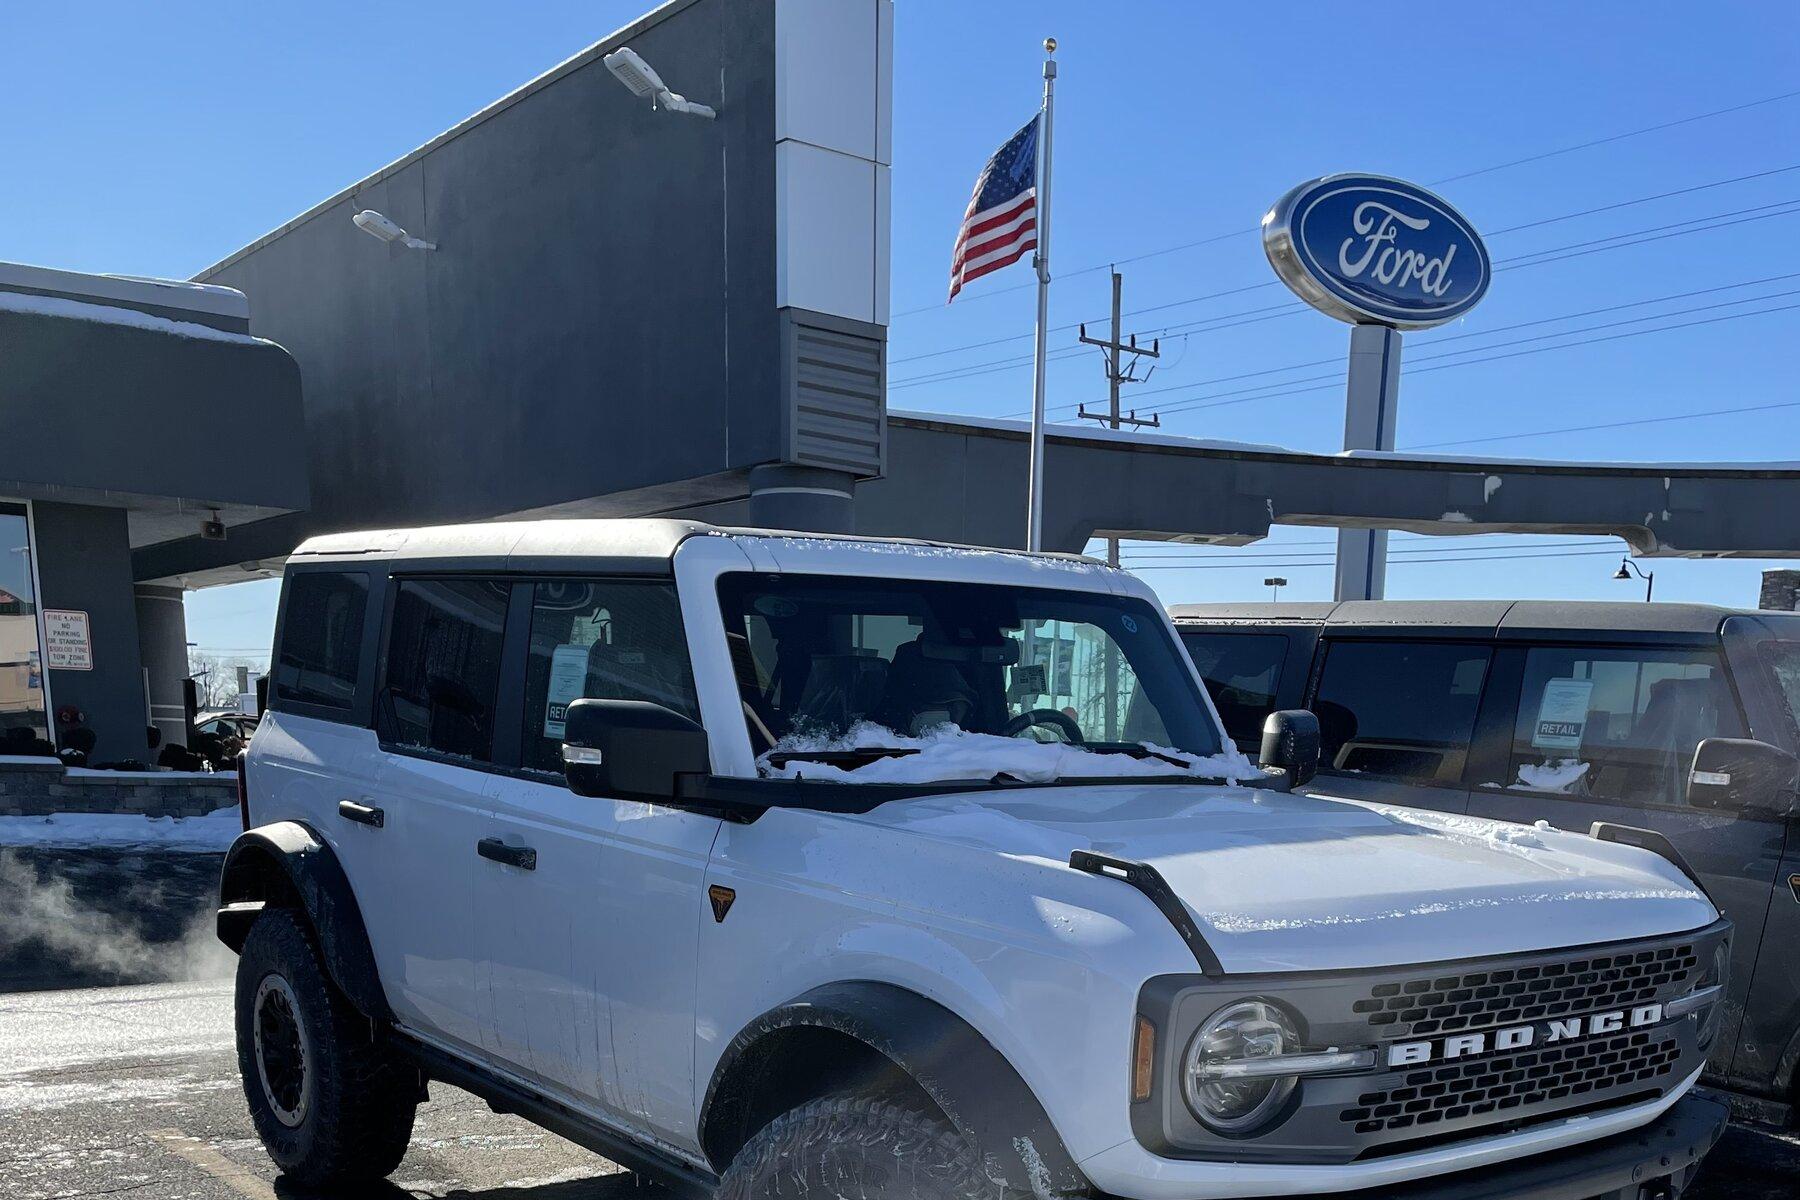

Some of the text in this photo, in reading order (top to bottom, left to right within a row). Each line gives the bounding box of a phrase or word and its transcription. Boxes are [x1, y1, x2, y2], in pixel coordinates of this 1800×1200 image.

[1338, 201, 1458, 297] Ford
[59, 638, 88, 646] STANDING
[549, 706, 567, 719] RET
[1541, 723, 1577, 735] RETAIL
[1387, 1003, 1663, 1067] BRONCO
